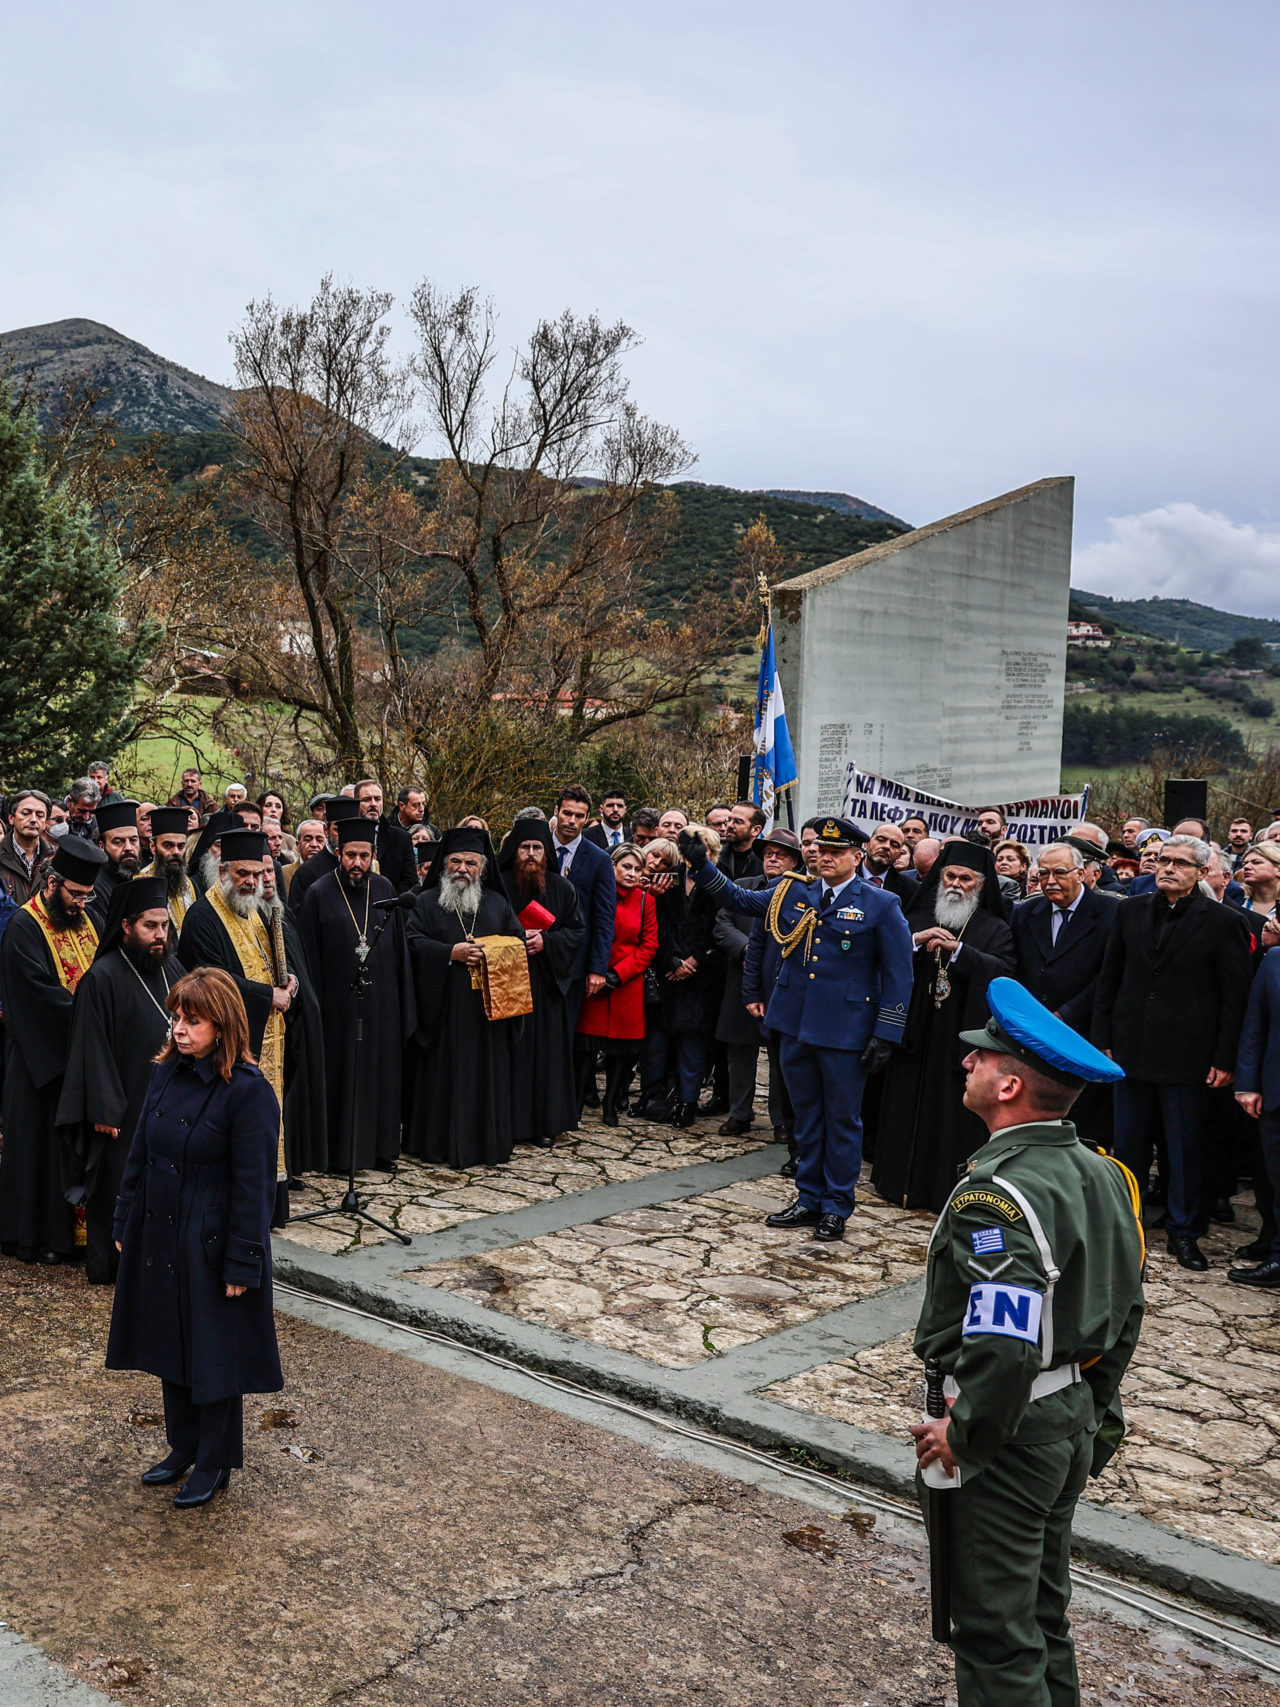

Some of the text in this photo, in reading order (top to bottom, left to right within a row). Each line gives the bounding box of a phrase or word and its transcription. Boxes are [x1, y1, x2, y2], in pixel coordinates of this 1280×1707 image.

[856, 774, 876, 794] ΝΑ
[878, 777, 911, 802] ΜΑΣ
[851, 798, 867, 818] ΤΑ
[928, 812, 961, 834] ΠΟΥ
[1006, 823, 1072, 844] ΡΩΣΤΑΝ
[955, 1192, 1016, 1218] ΣΤΡΑΤΟΝΟΜΙΑ
